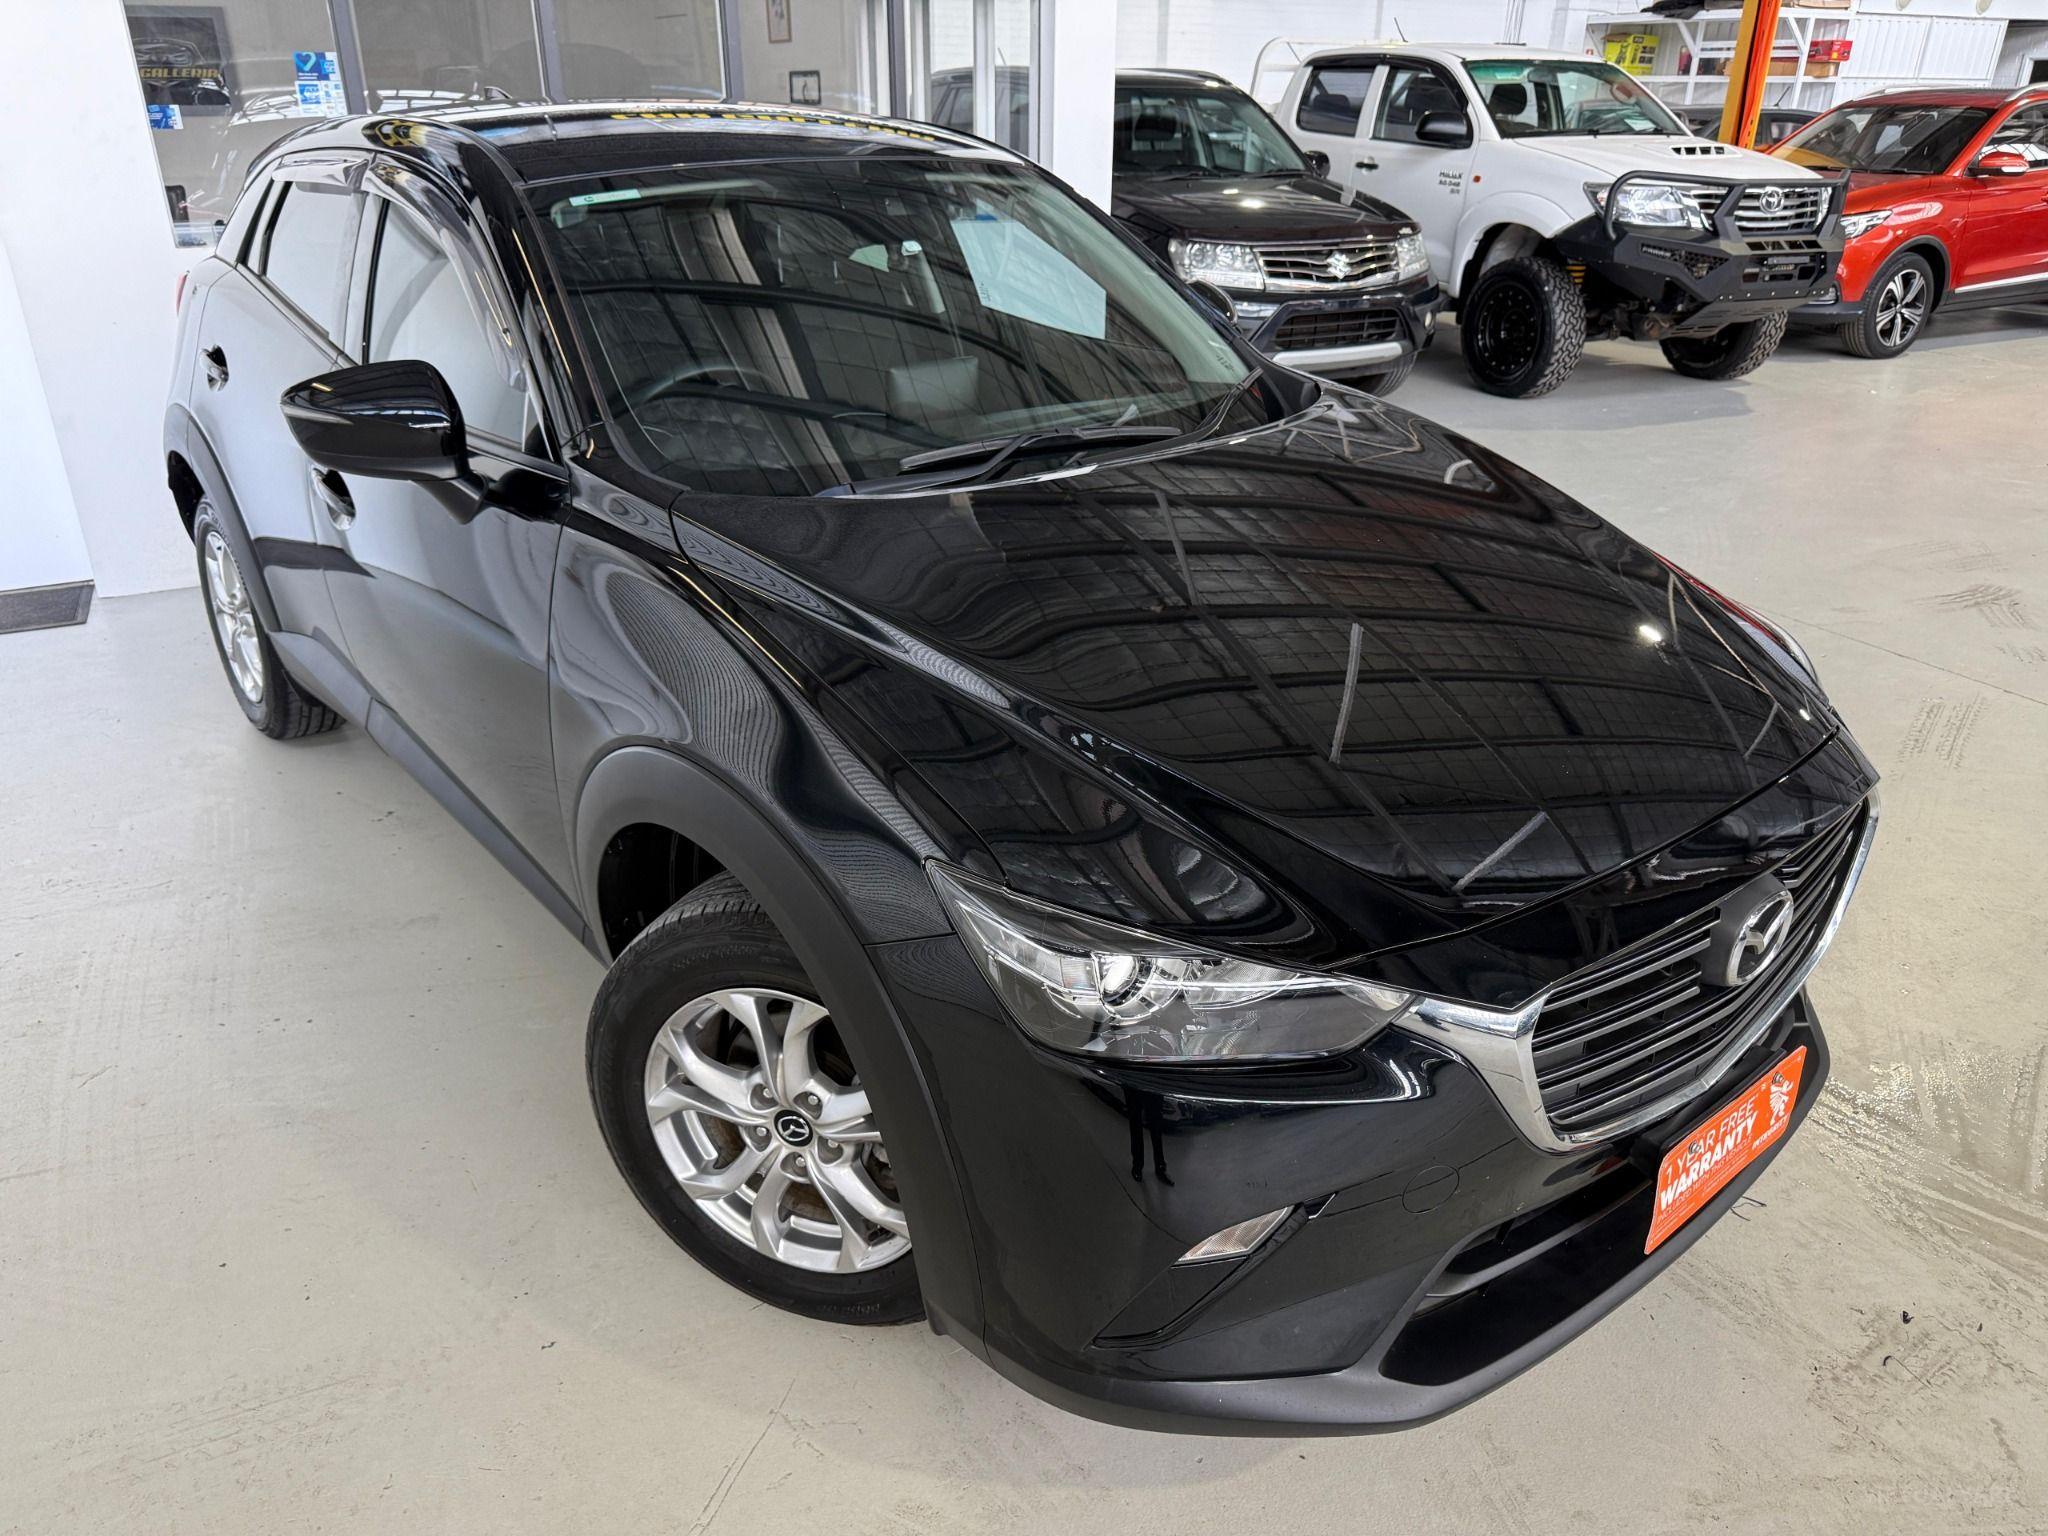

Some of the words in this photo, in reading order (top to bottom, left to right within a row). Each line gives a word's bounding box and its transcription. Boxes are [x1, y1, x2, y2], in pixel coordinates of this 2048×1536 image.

[140, 67, 219, 78] GALLERIA
[1661, 1111, 1758, 1211] WARRANTY
[1666, 1164, 1673, 1185] 1
[1677, 1128, 1717, 1173] YEAR
